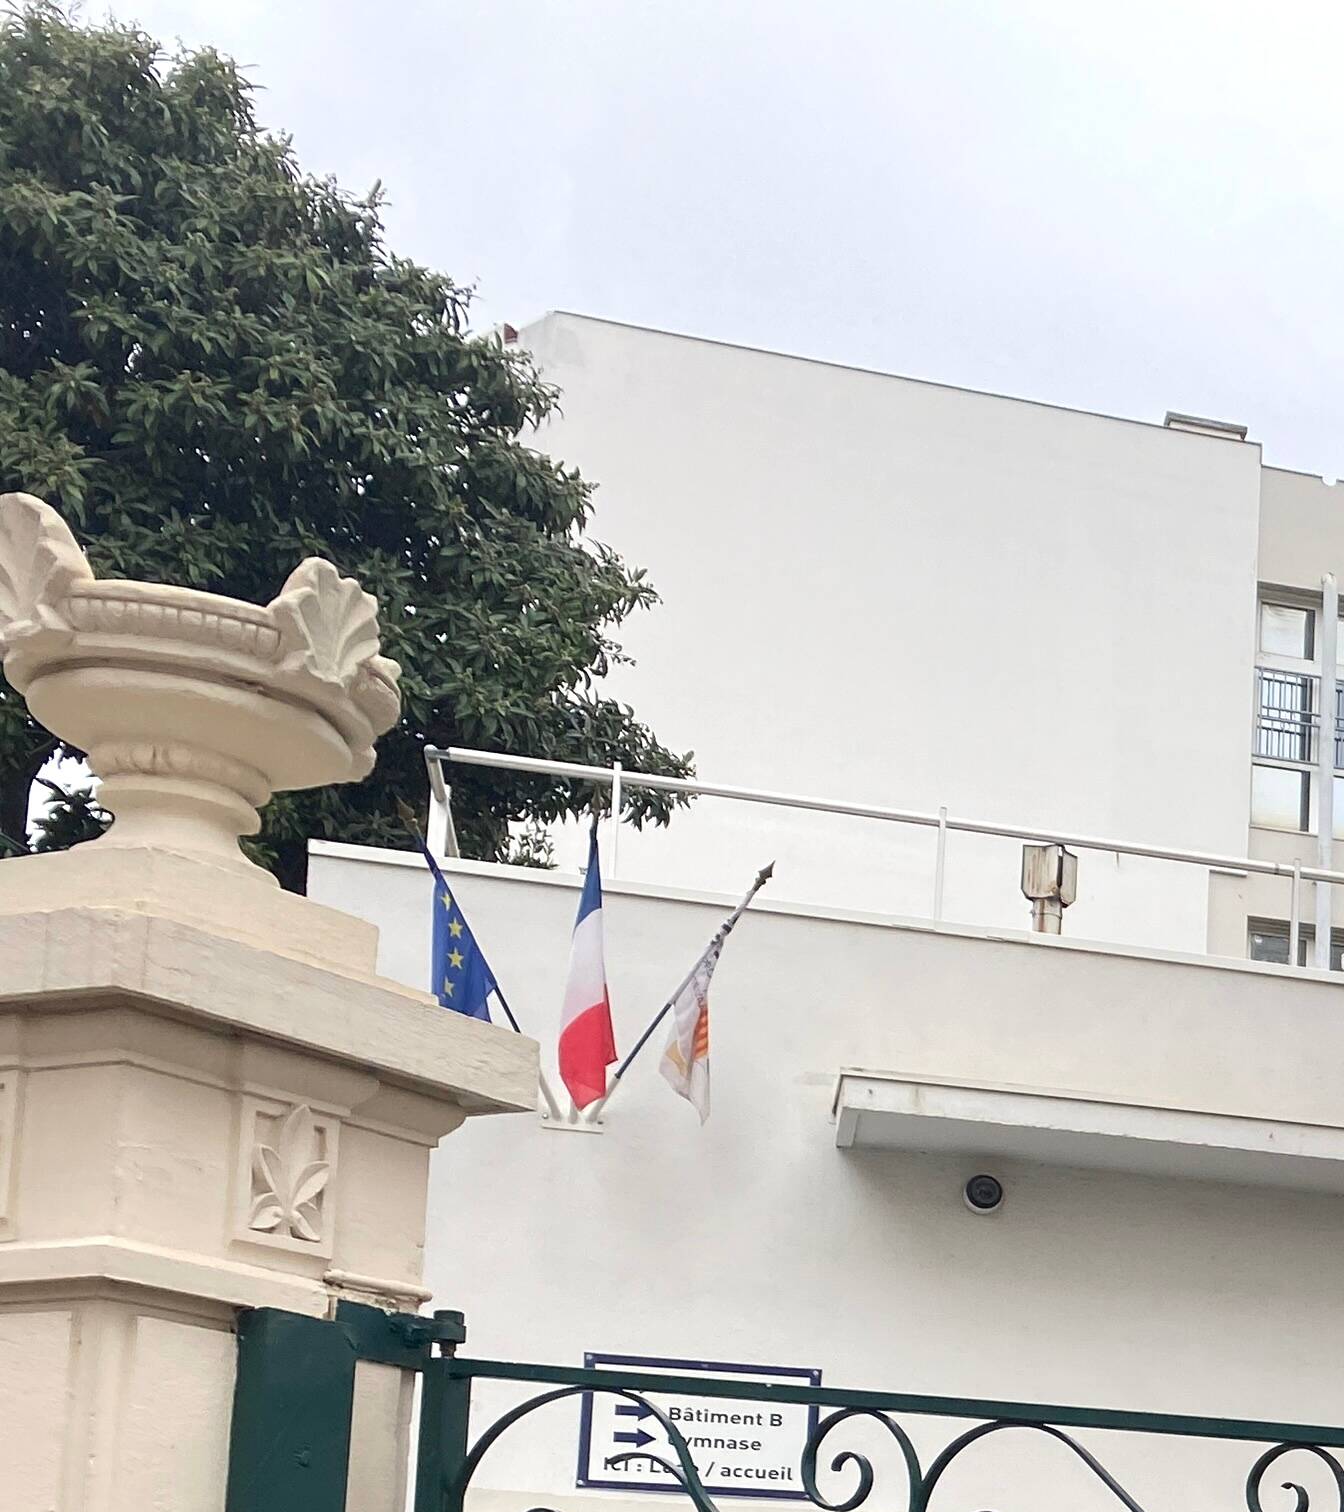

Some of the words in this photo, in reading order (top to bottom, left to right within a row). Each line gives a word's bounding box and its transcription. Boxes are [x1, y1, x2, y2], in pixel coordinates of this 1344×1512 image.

[668, 1406, 763, 1427] Bâtiment
[769, 1413, 783, 1427] B
[720, 1465, 793, 1481] accueil
